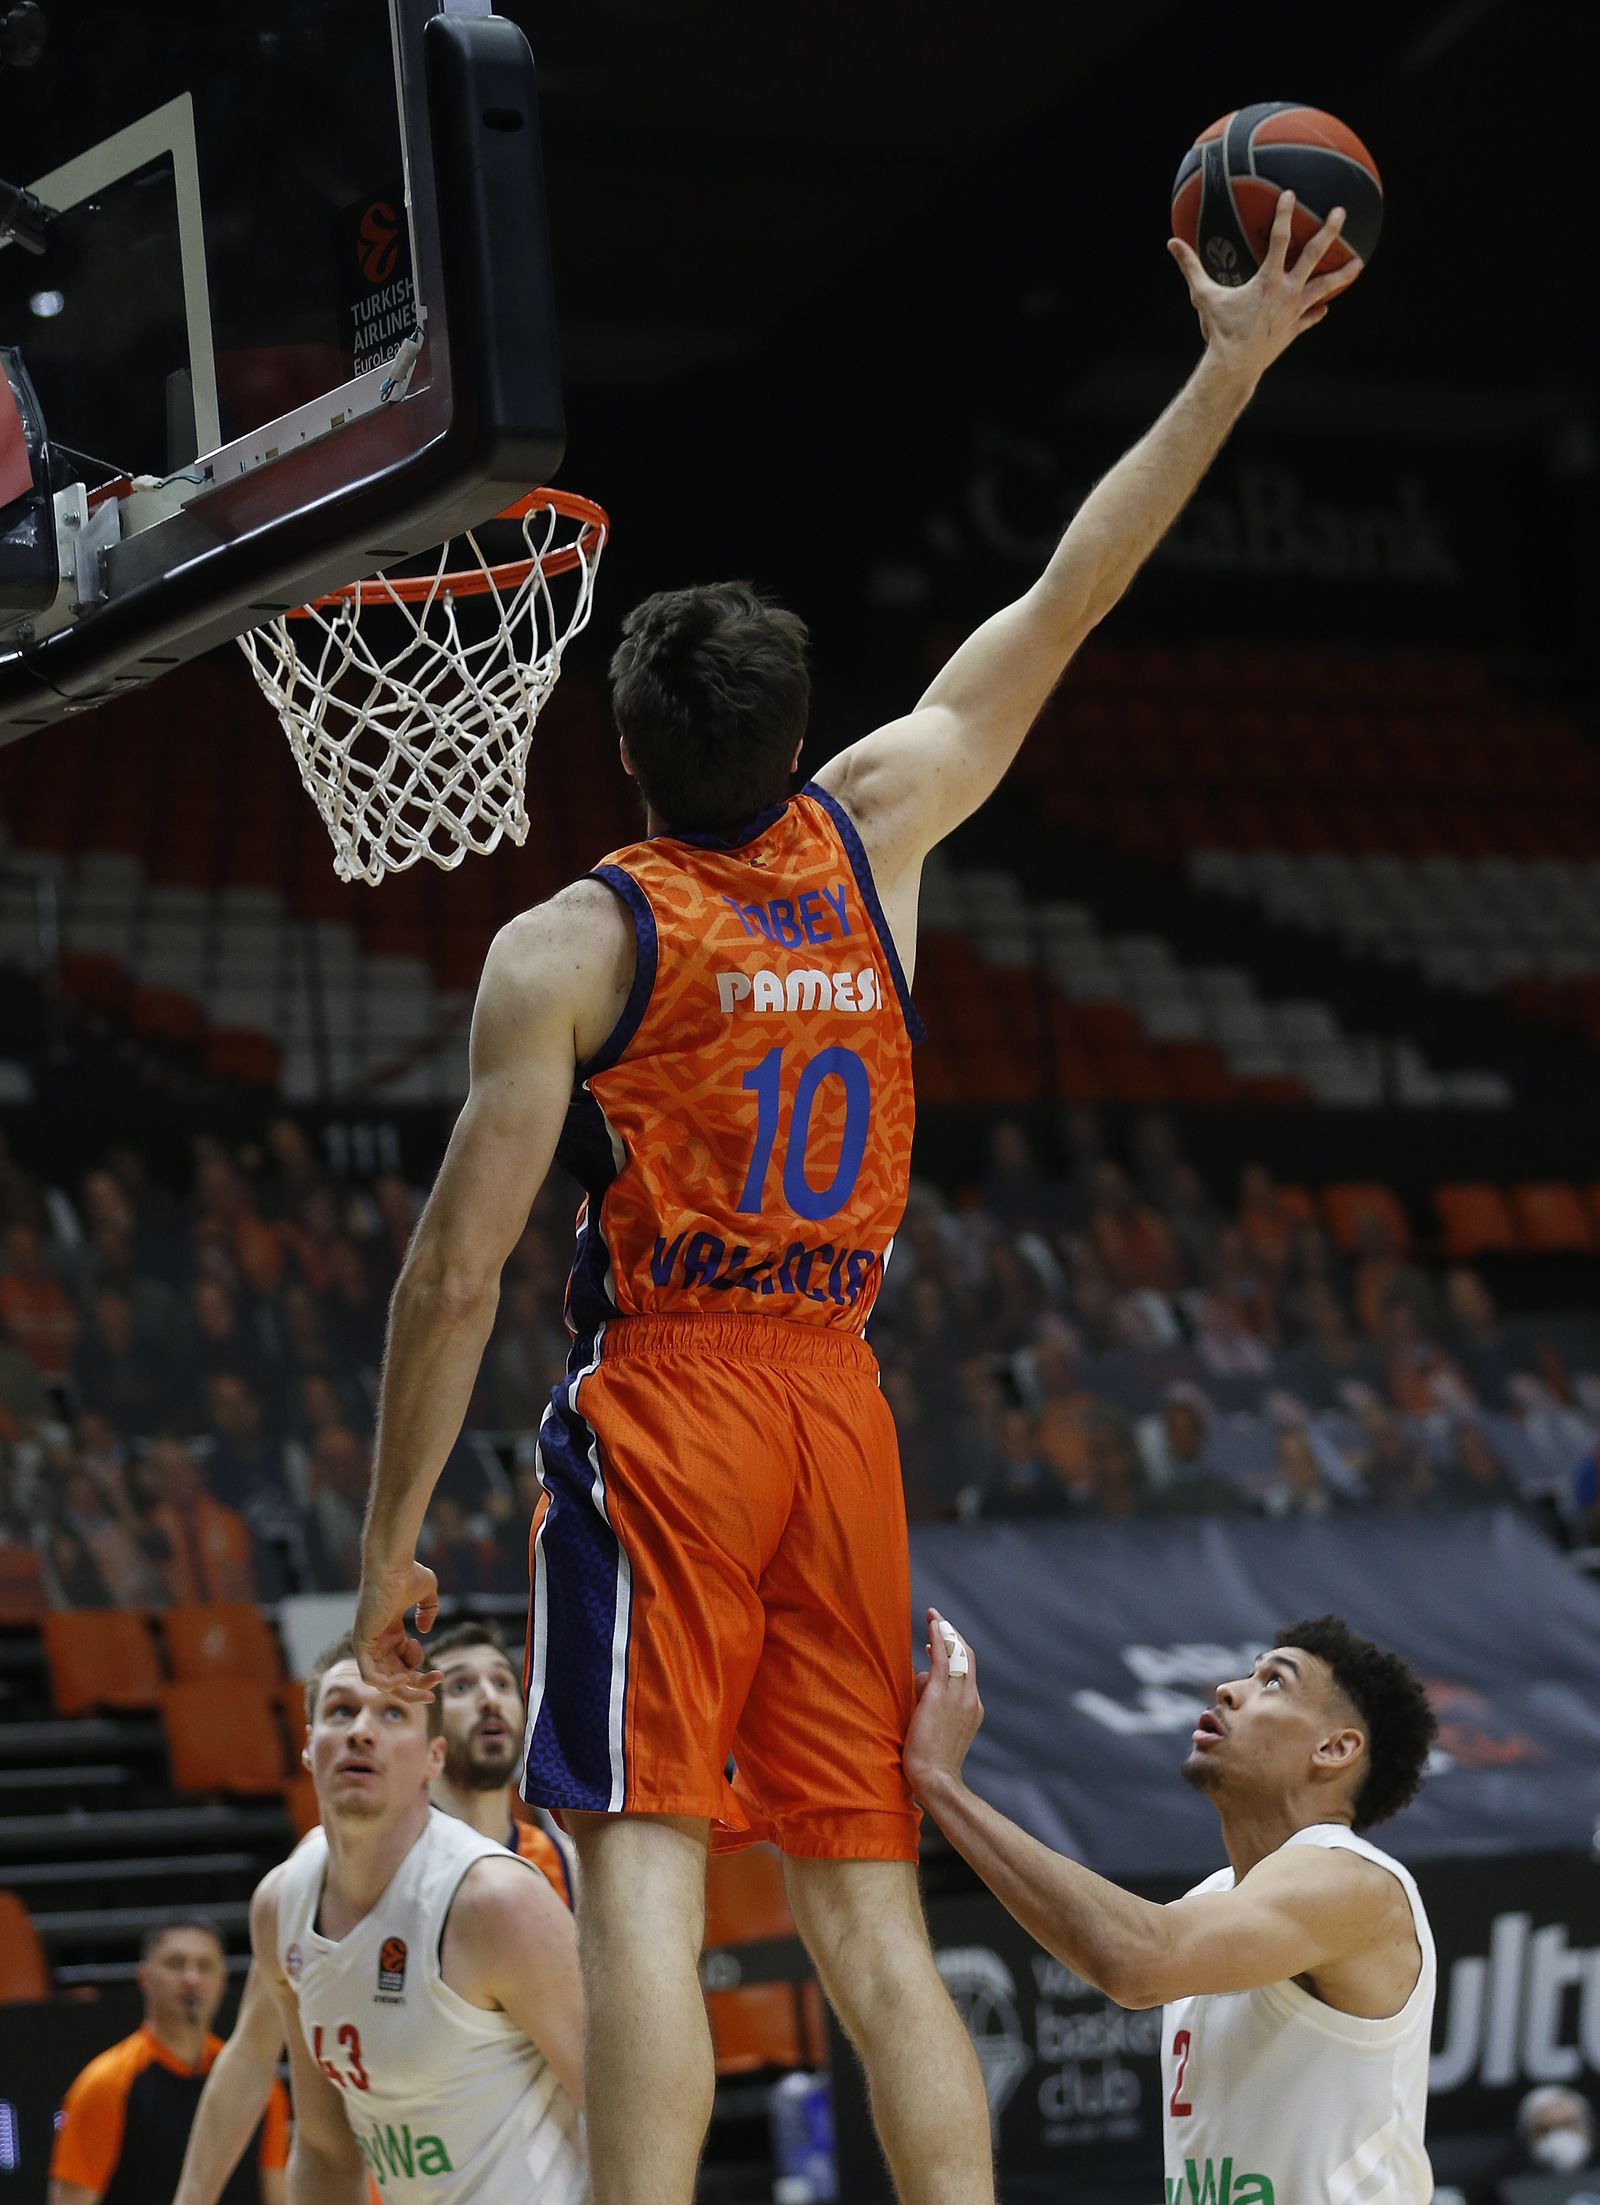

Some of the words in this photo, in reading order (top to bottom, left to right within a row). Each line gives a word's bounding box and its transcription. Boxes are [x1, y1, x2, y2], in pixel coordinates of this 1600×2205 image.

[351, 277, 413, 326] TURKISH
[353, 342, 400, 377] EuroLea
[716, 967, 882, 1013] PAMES
[736, 1046, 870, 1219] 10
[313, 2024, 369, 2090] 43
[1170, 2030, 1191, 2116] 2
